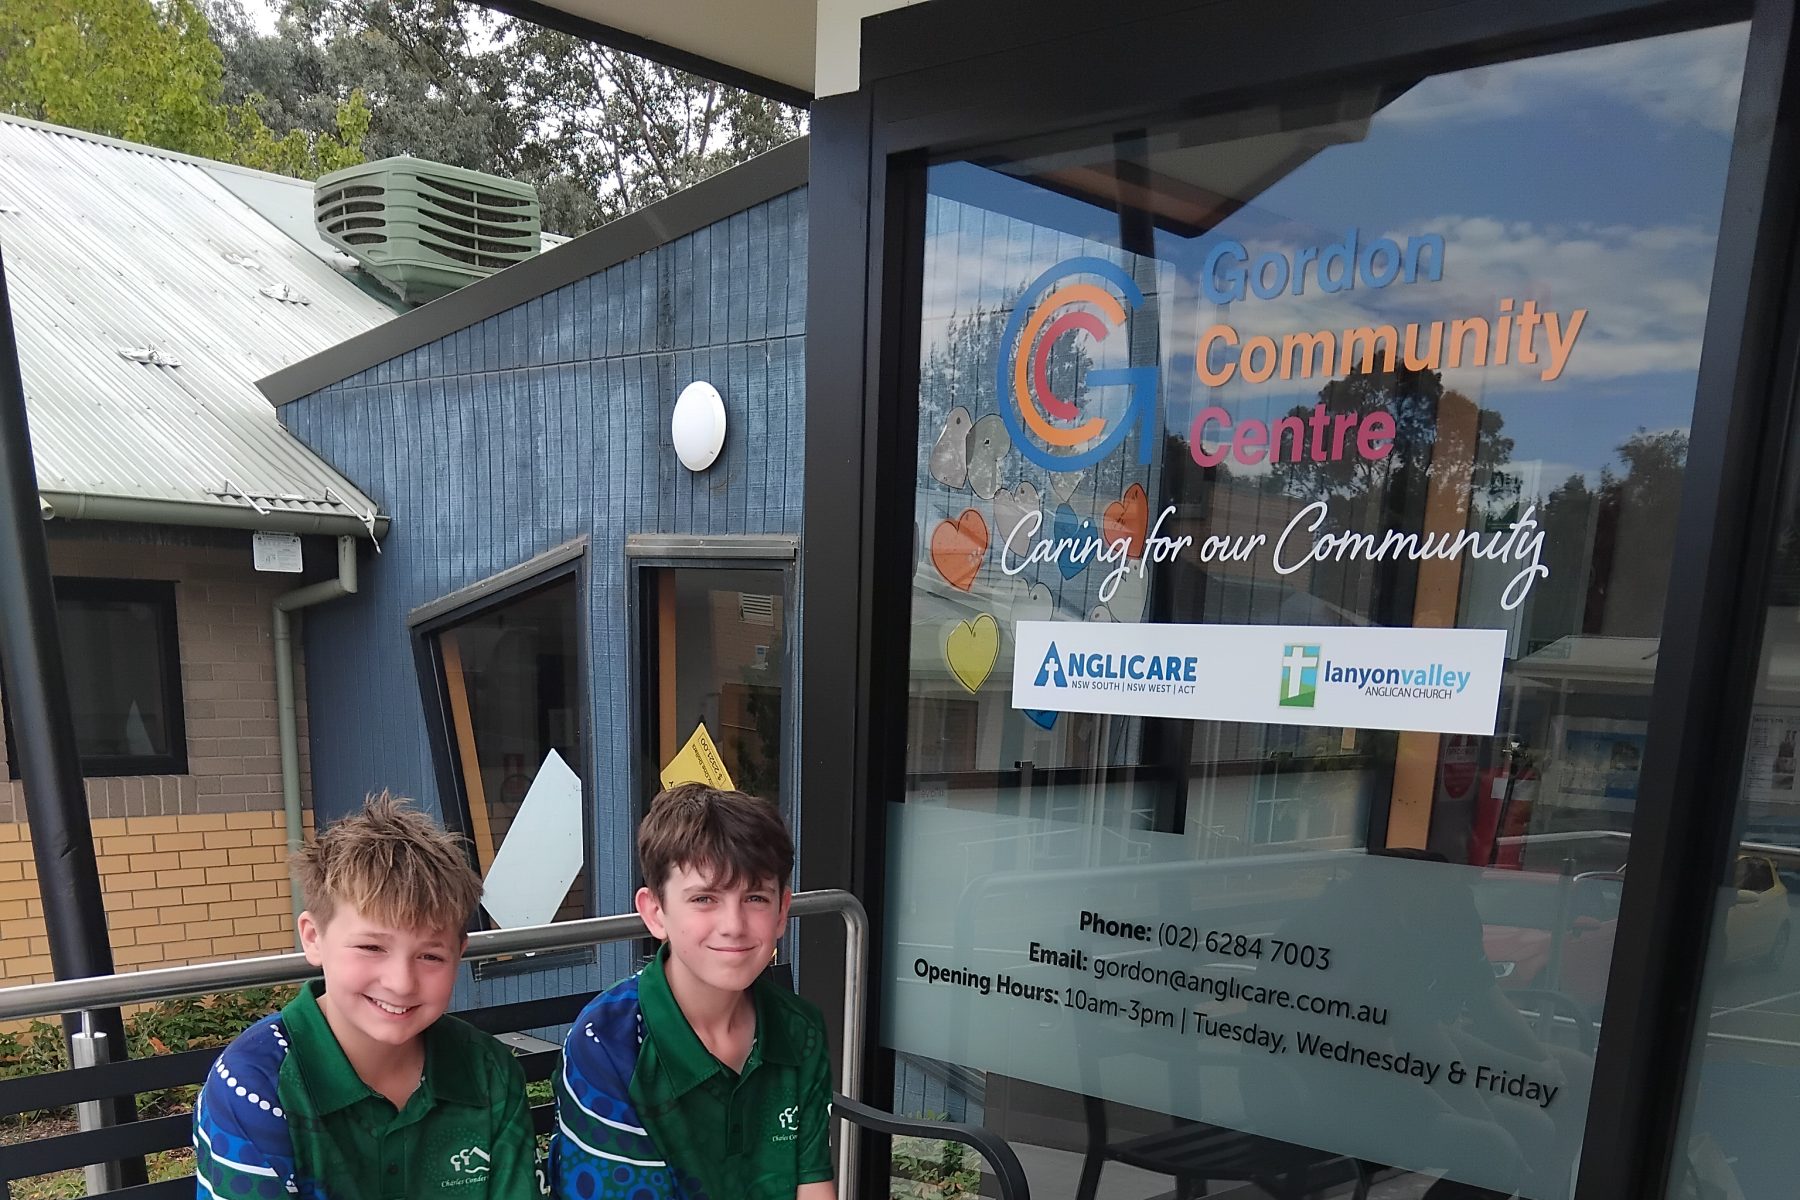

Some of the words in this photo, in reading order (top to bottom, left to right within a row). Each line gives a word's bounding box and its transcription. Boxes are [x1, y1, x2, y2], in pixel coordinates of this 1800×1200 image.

[1202, 228, 1445, 305] Gordon
[1196, 299, 1589, 387] Community
[1190, 405, 1396, 467] Centre
[1000, 508, 1132, 602] Caring
[1140, 506, 1191, 579] for
[1200, 532, 1266, 563] our
[1273, 501, 1550, 610] Community
[1033, 641, 1198, 688] ANGLICARE
[1071, 681, 1090, 690] NSW
[1091, 681, 1120, 691] SOUTH
[1127, 683, 1146, 692] NSW
[1149, 684, 1171, 693] WEST
[1178, 685, 1196, 694] ACT
[1324, 660, 1471, 693] lanyonvalley
[1364, 686, 1412, 698] ANGLICAN
[1412, 688, 1453, 699] CHURCH
[1079, 910, 1152, 942] Phone:
[1157, 921, 1199, 951] (02)
[1204, 929, 1263, 960] 6284
[1270, 938, 1332, 972] 7003
[1028, 941, 1088, 972] Email:
[1093, 955, 1389, 1026] gordon@anglicare.com.au
[914, 958, 991, 995] Opening
[996, 973, 1059, 1005] Hours:
[1064, 987, 1175, 1030] 10am-3pm
[1194, 1012, 1288, 1055] Tuesday,
[1296, 1031, 1441, 1085] Wednesday
[1447, 1062, 1467, 1086] &
[1474, 1065, 1559, 1109] Friday
